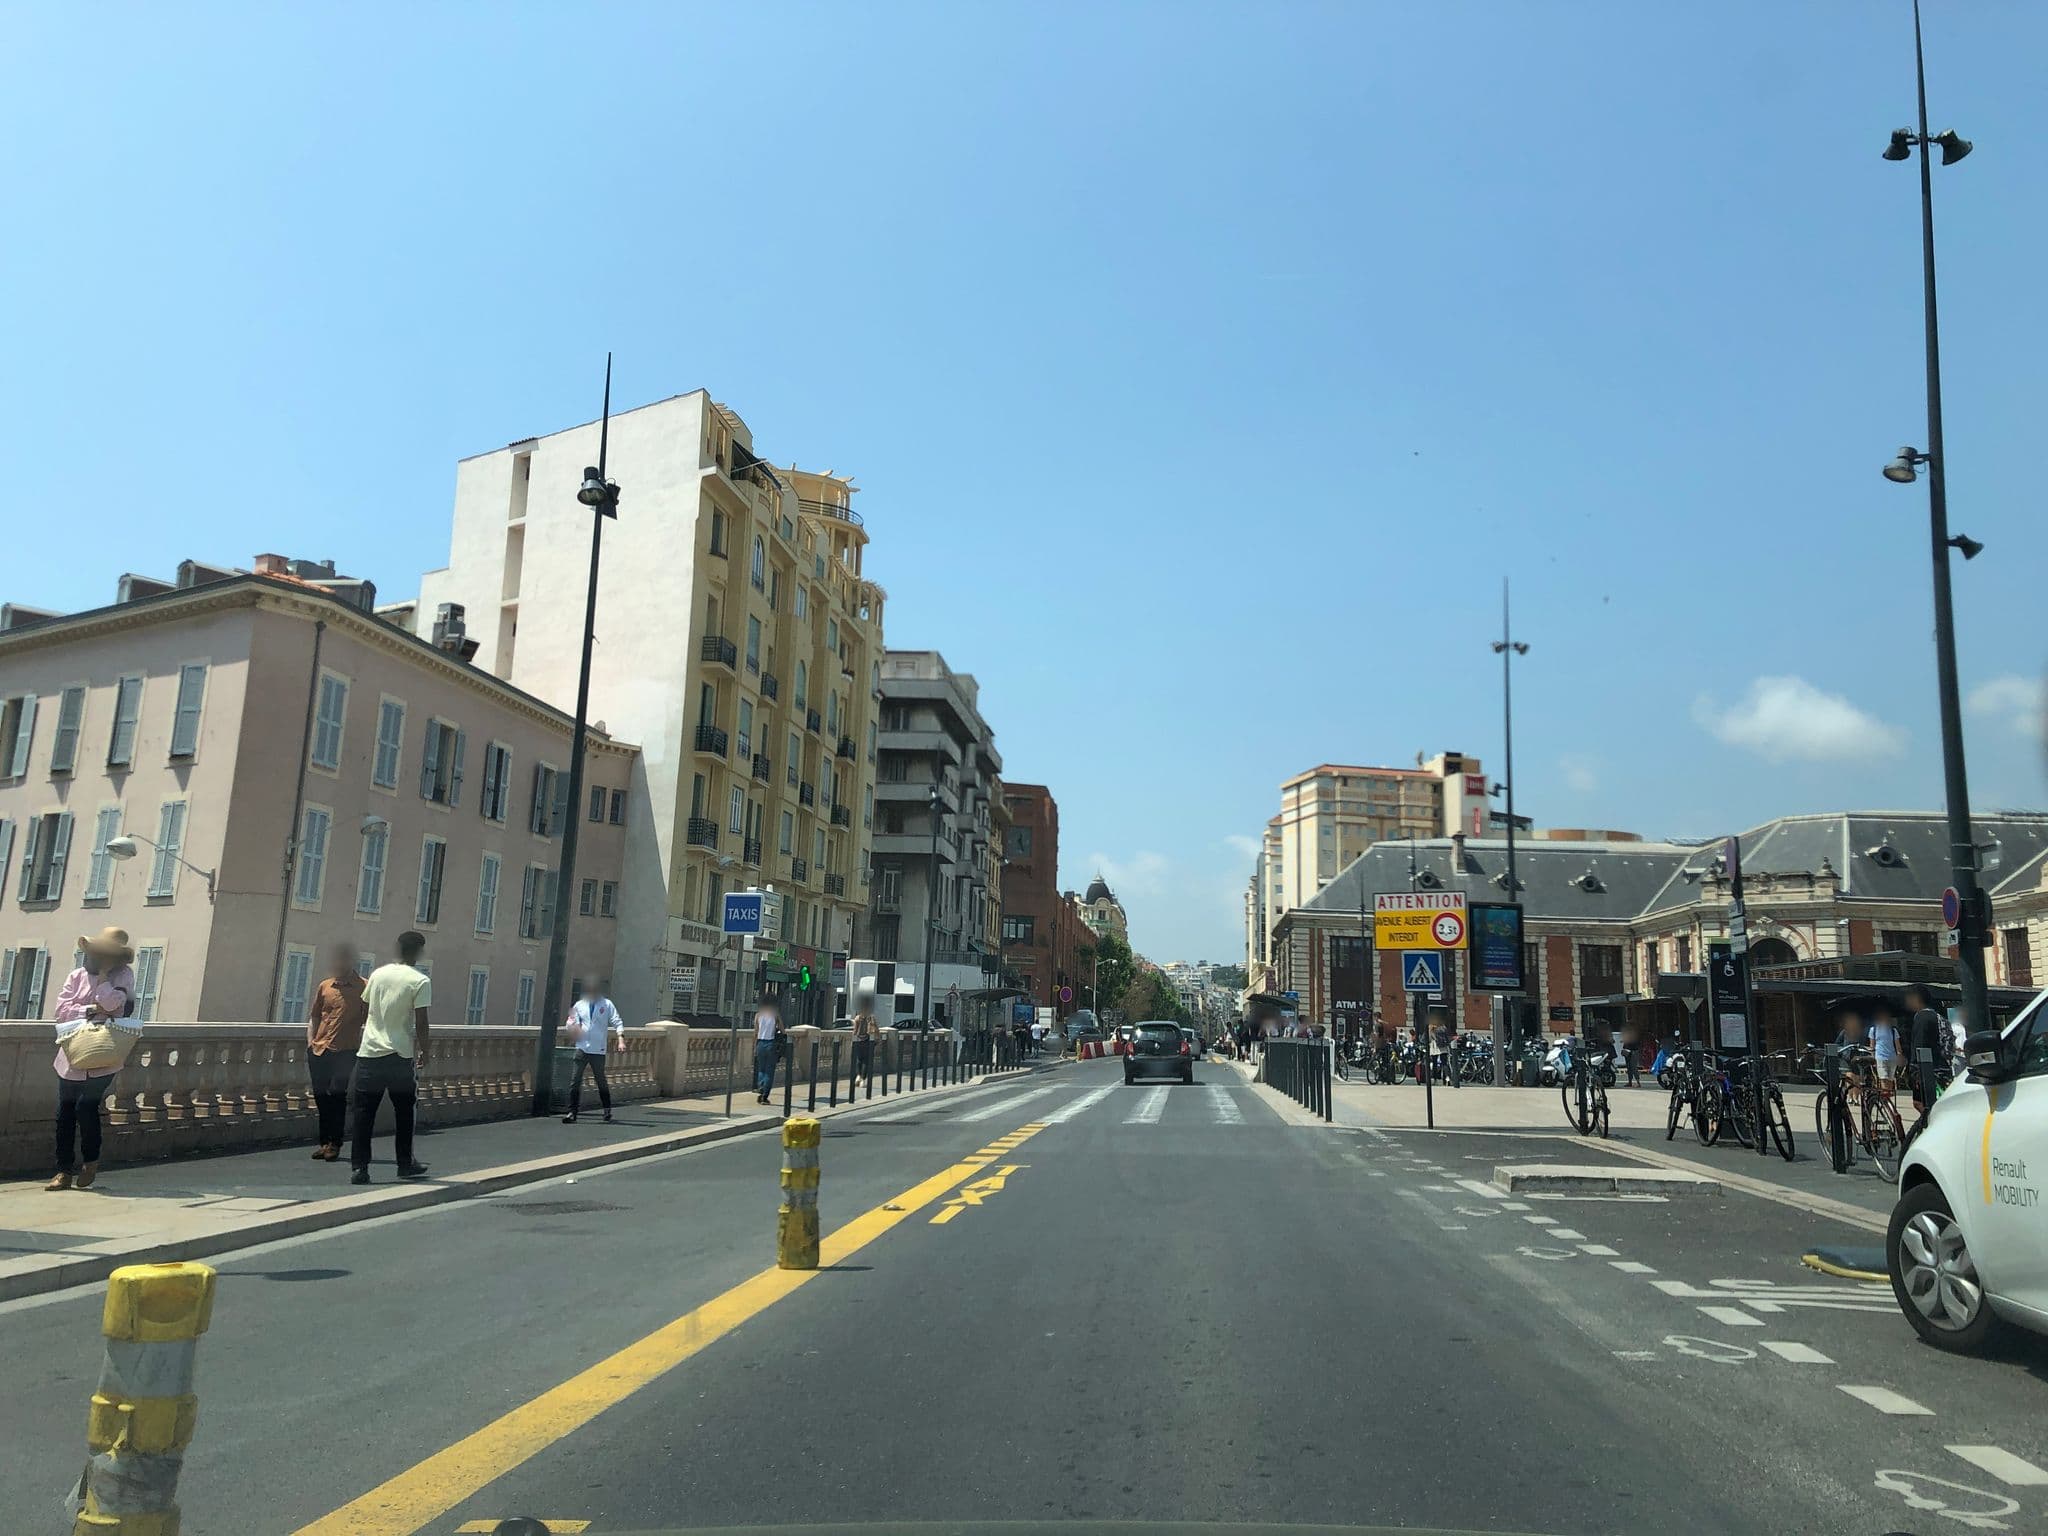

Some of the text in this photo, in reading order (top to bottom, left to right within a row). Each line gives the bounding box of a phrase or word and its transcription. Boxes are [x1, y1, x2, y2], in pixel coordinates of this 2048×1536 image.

[1378, 894, 1462, 909] ATTENTION
[728, 908, 758, 920] TAXIS
[1376, 915, 1402, 926] AVENUE
[1388, 932, 1419, 942] INTERDIT
[1336, 1000, 1356, 1009] ATM
[1993, 1157, 2027, 1180] Renault
[1995, 1184, 2039, 1207] MOBILITY
